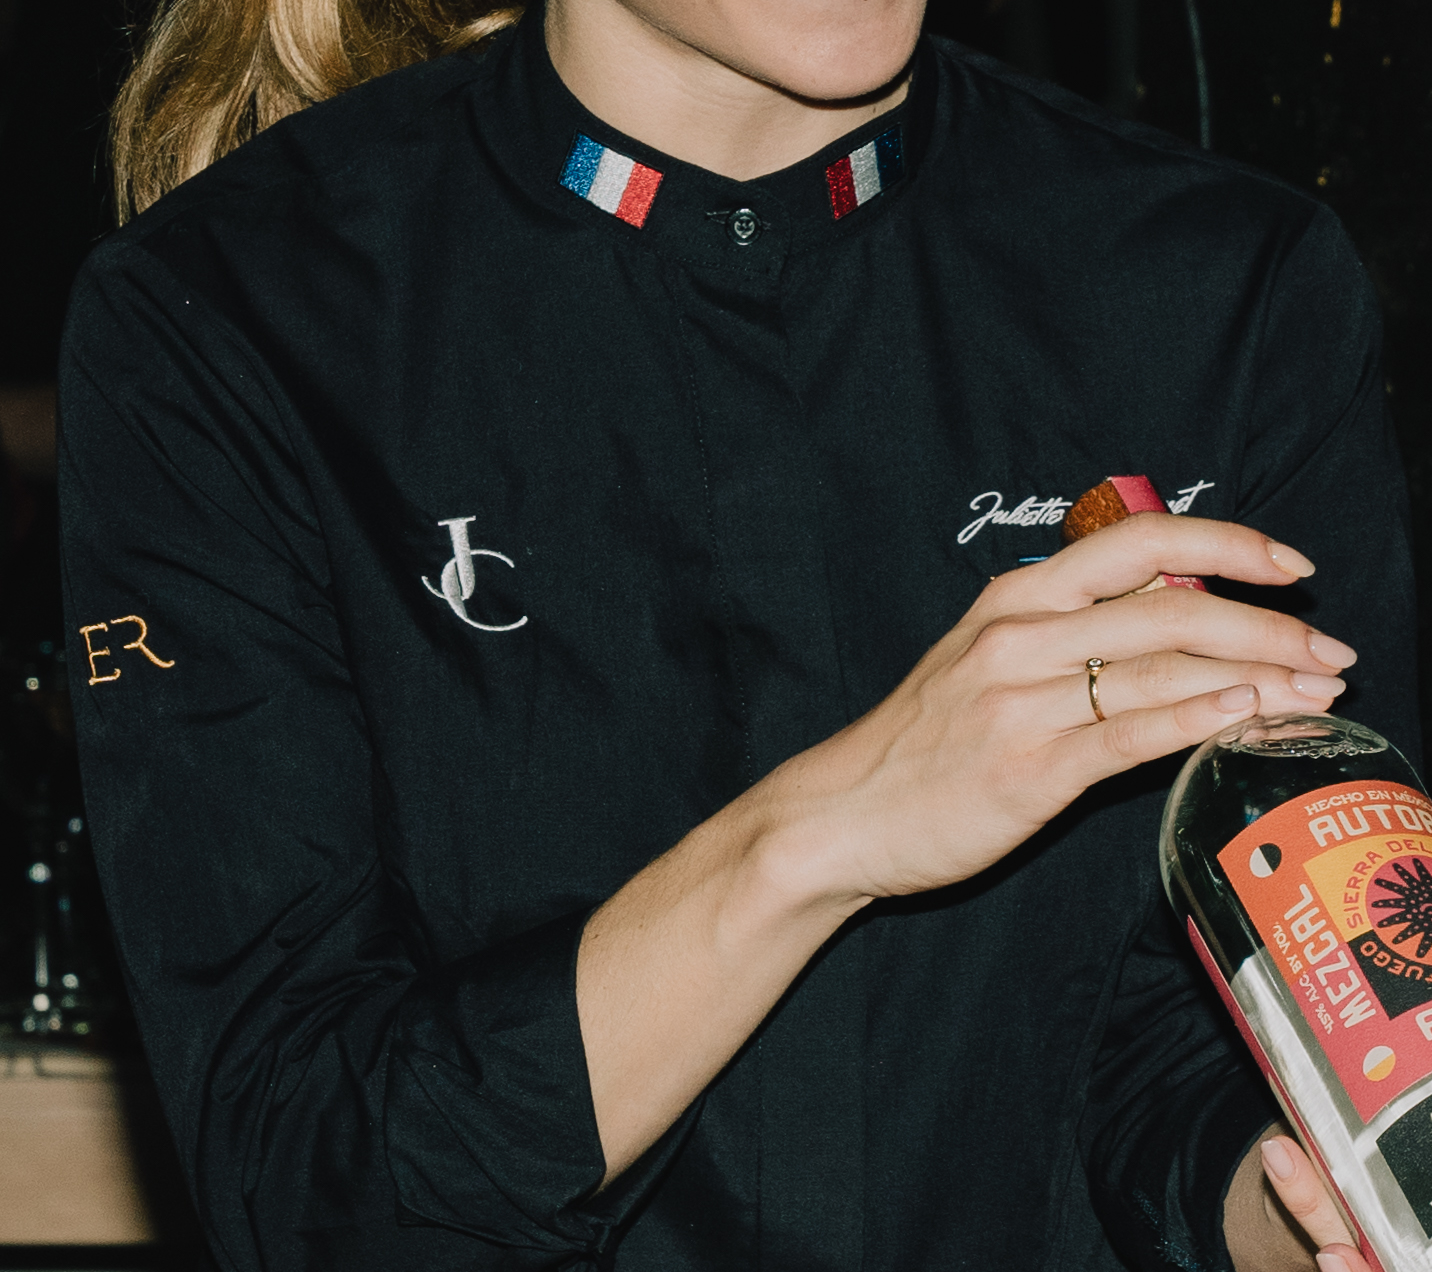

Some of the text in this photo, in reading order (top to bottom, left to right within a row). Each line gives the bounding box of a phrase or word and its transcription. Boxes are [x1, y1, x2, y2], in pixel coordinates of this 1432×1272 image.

[957, 491, 1072, 544] Juliette
[1304, 791, 1365, 817] HECHO
[1367, 790, 1390, 801] EN
[1344, 851, 1384, 930] SIERRA
[1283, 884, 1377, 1029] MEZCAL
[1286, 954, 1303, 974] BY
